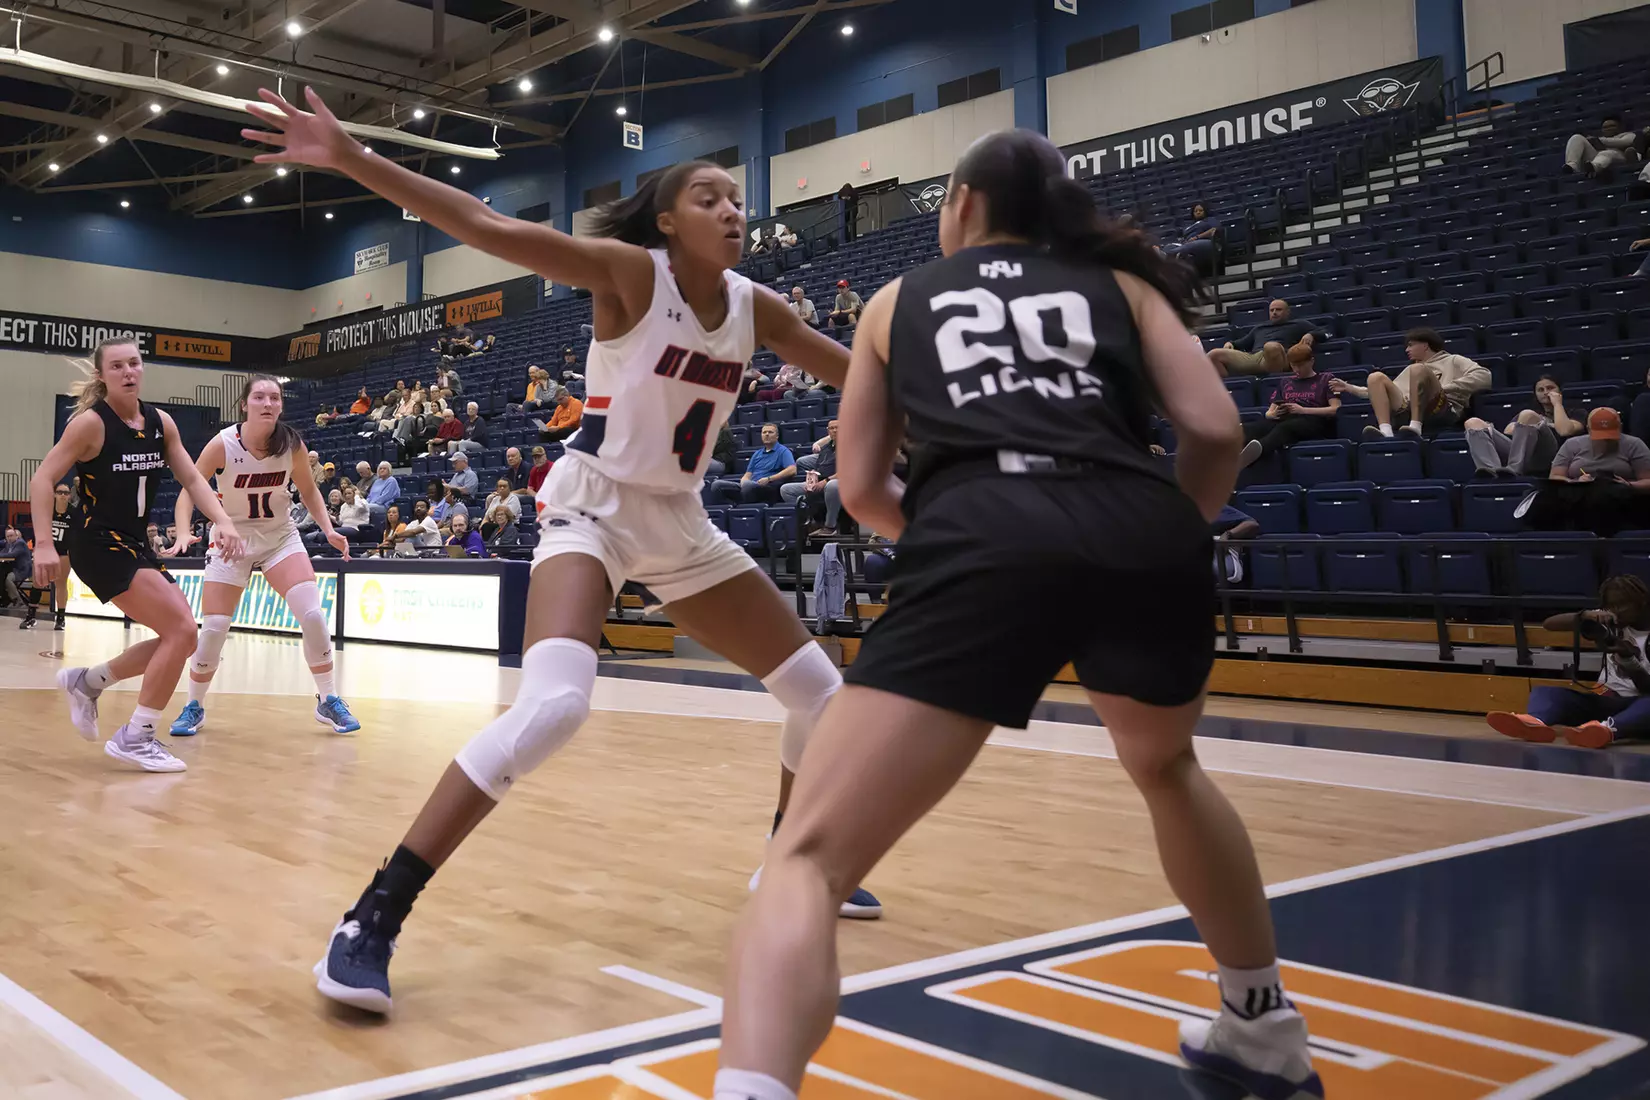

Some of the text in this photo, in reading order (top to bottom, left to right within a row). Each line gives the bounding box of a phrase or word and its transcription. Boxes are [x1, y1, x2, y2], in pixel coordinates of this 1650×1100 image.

[627, 131, 640, 146] B
[1113, 133, 1175, 168] THIS
[42, 321, 78, 348] THIS
[326, 320, 376, 353] PROTECT
[376, 314, 397, 343] THIS
[929, 287, 1097, 373] 20
[190, 343, 224, 356] WILL
[947, 366, 1104, 409] LIONS
[672, 398, 716, 474] 4
[122, 452, 161, 462] NORTH
[137, 475, 148, 518] 1
[247, 491, 275, 519] 11
